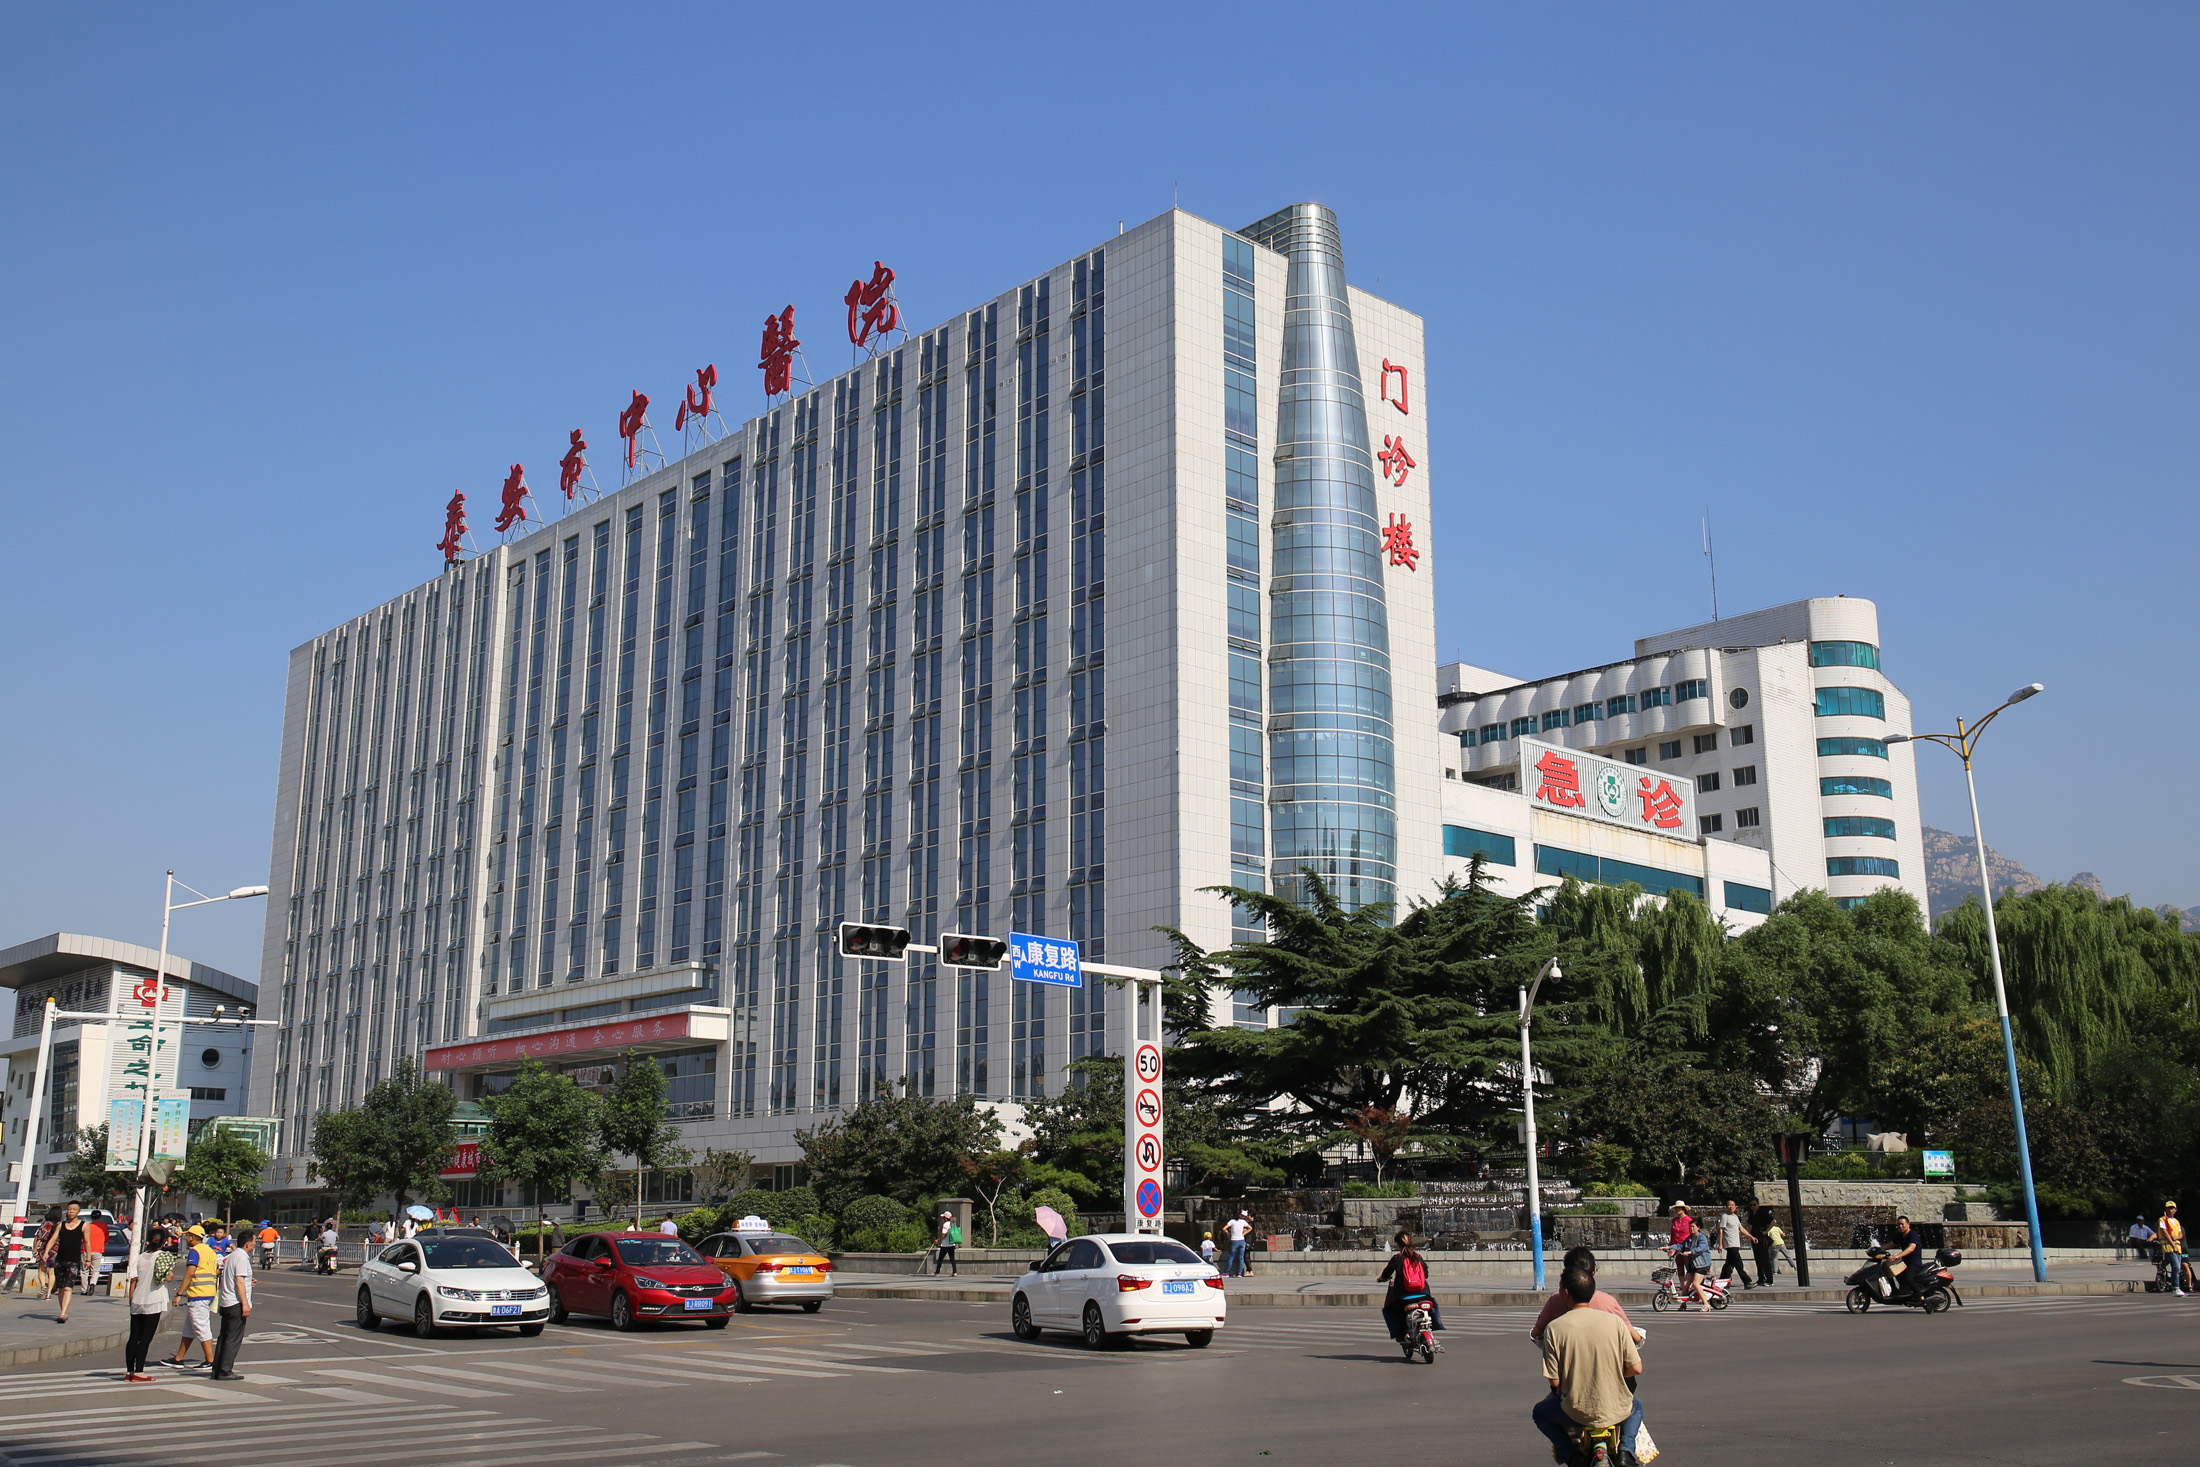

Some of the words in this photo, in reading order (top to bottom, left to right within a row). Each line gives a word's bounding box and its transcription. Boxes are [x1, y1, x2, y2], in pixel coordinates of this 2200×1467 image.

[1378, 358, 1419, 571] 门诊楼
[1535, 751, 1683, 828] 急诊
[1011, 945, 1021, 957] 西
[1028, 941, 1077, 972] 康复路
[1014, 959, 1021, 969] W
[1033, 969, 1063, 981] KANGFU
[1065, 973, 1074, 982] Rd
[441, 1044, 497, 1064] 耐心倾听
[515, 1033, 577, 1055] 细心沟通
[592, 1020, 665, 1045] 全心服务
[1140, 1055, 1157, 1072] 50
[1137, 1219, 1161, 1228] 康复路
